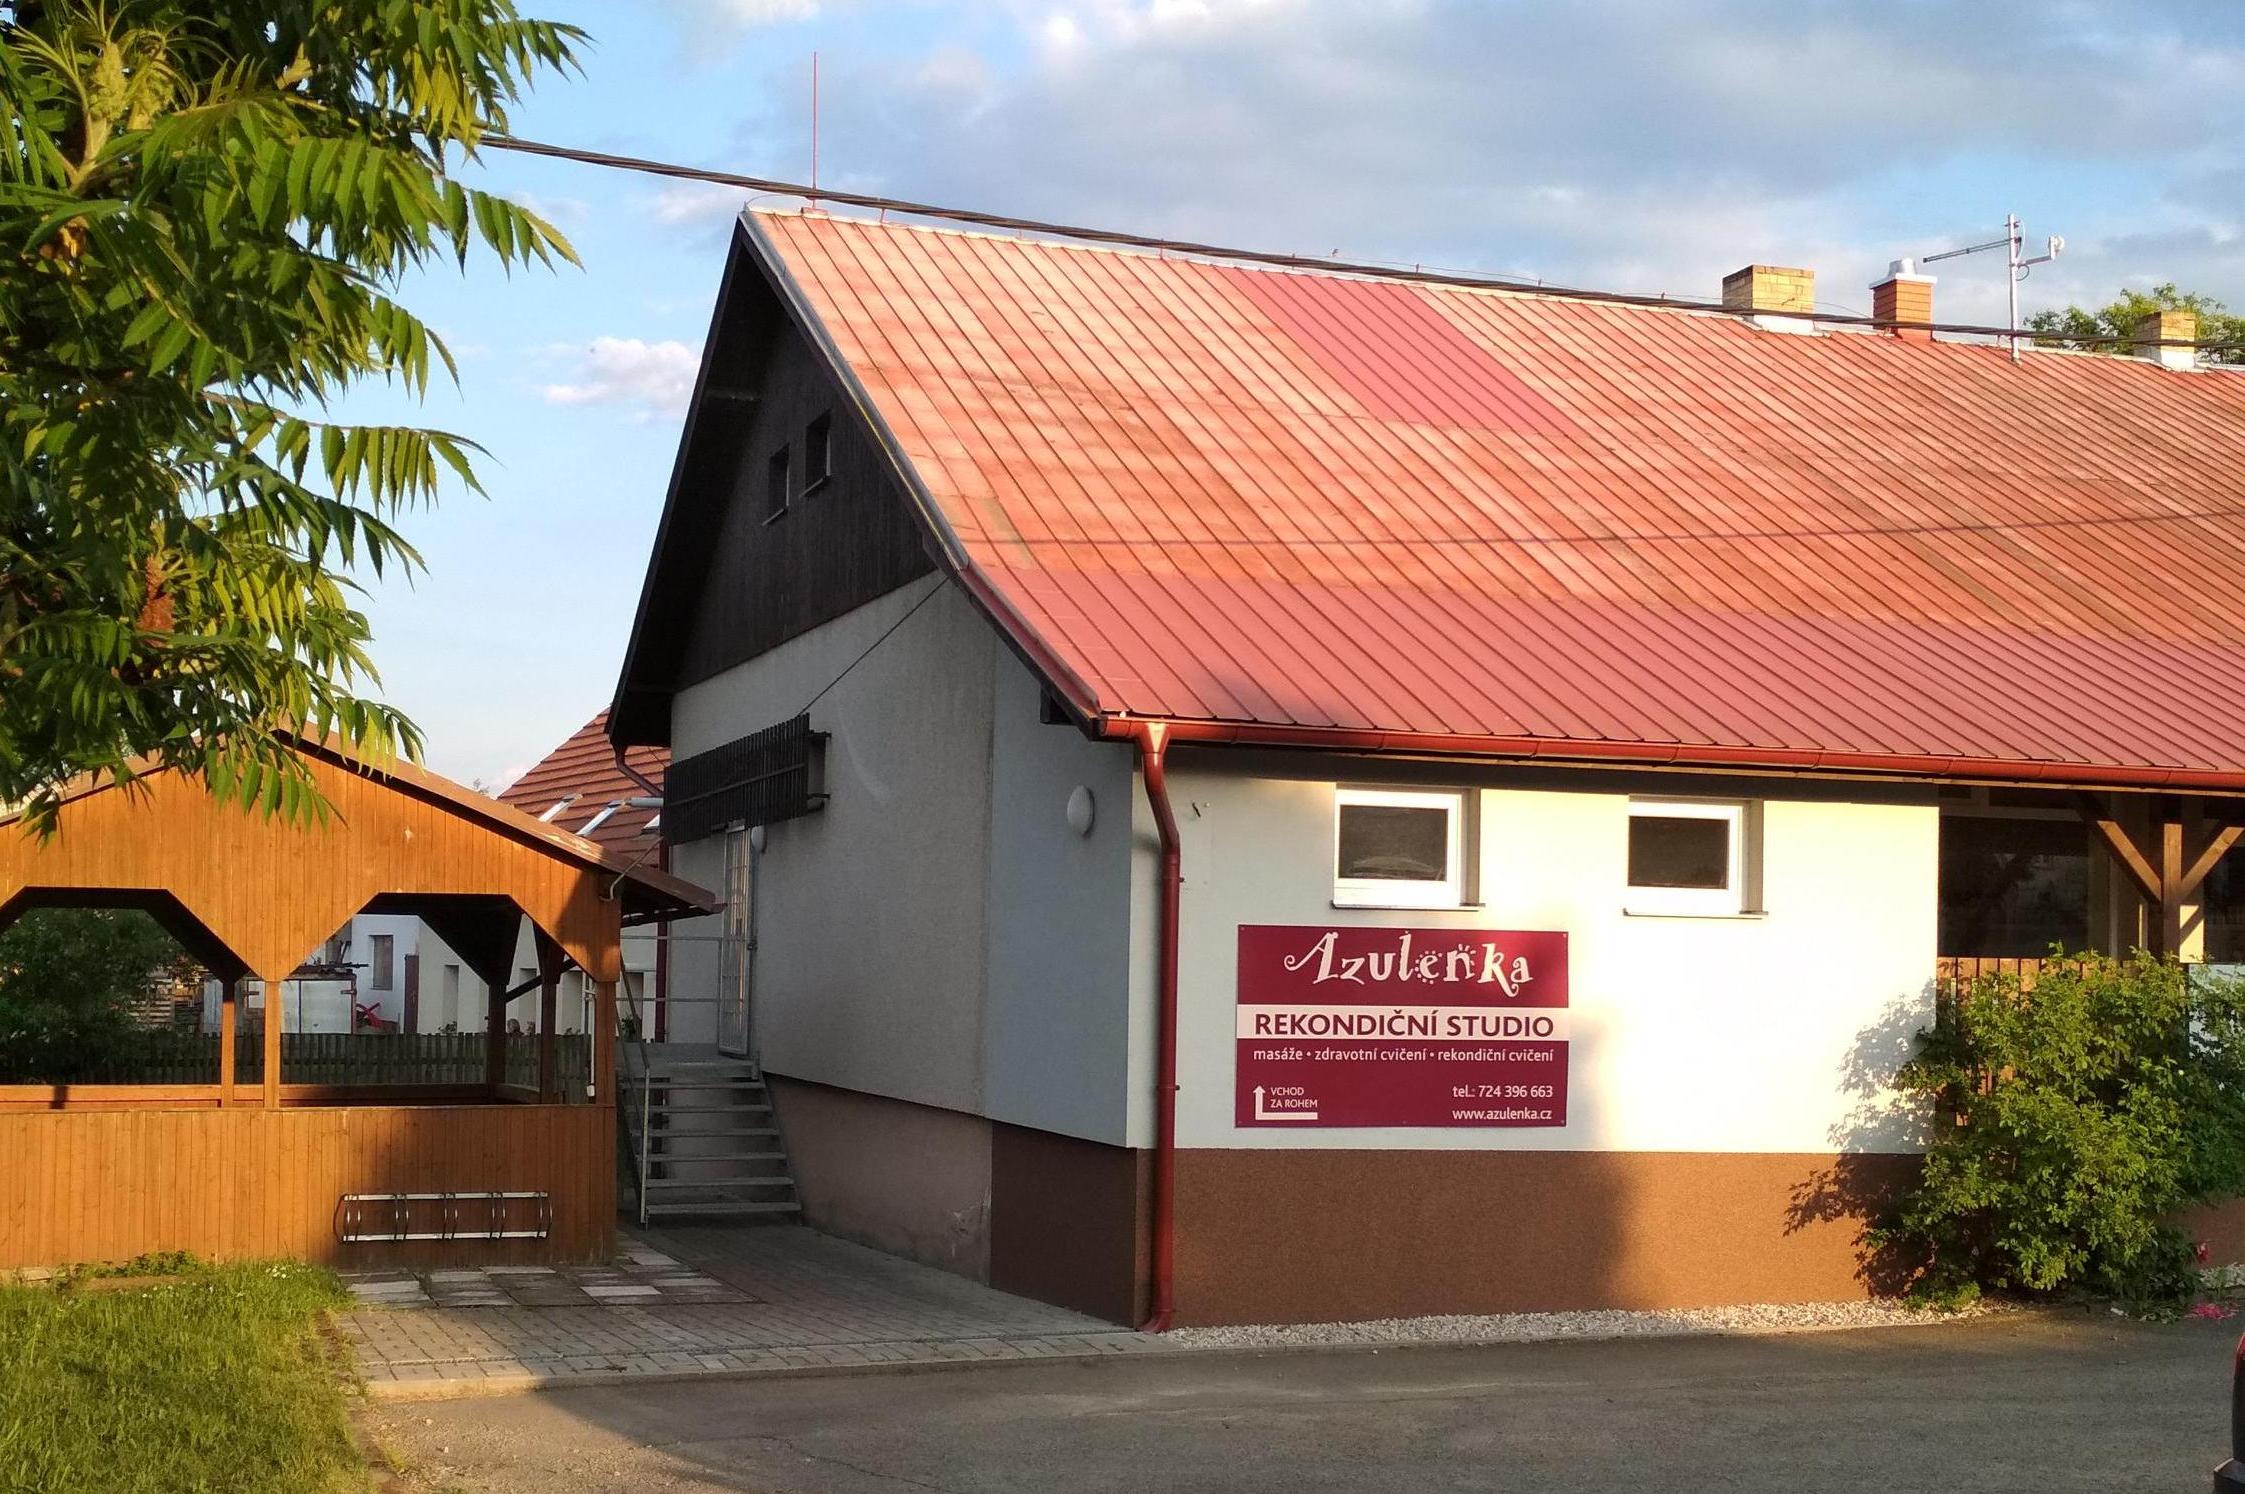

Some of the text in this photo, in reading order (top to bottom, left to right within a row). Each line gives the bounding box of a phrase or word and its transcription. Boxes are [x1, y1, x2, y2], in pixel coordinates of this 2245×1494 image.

[1255, 1009, 1554, 1037] REKONDIČNÍ STUDIO
[1253, 1047, 1554, 1062] masáže zdravotní cvičení rekondiční cvičení
[1270, 1087, 1304, 1096] VCHOD
[1478, 1085, 1501, 1098] 724
[1504, 1085, 1527, 1098] 396
[1530, 1085, 1553, 1098] 663
[1270, 1099, 1318, 1109] ZA ROHEM
[1452, 1107, 1552, 1120] www.azulenka.cz
